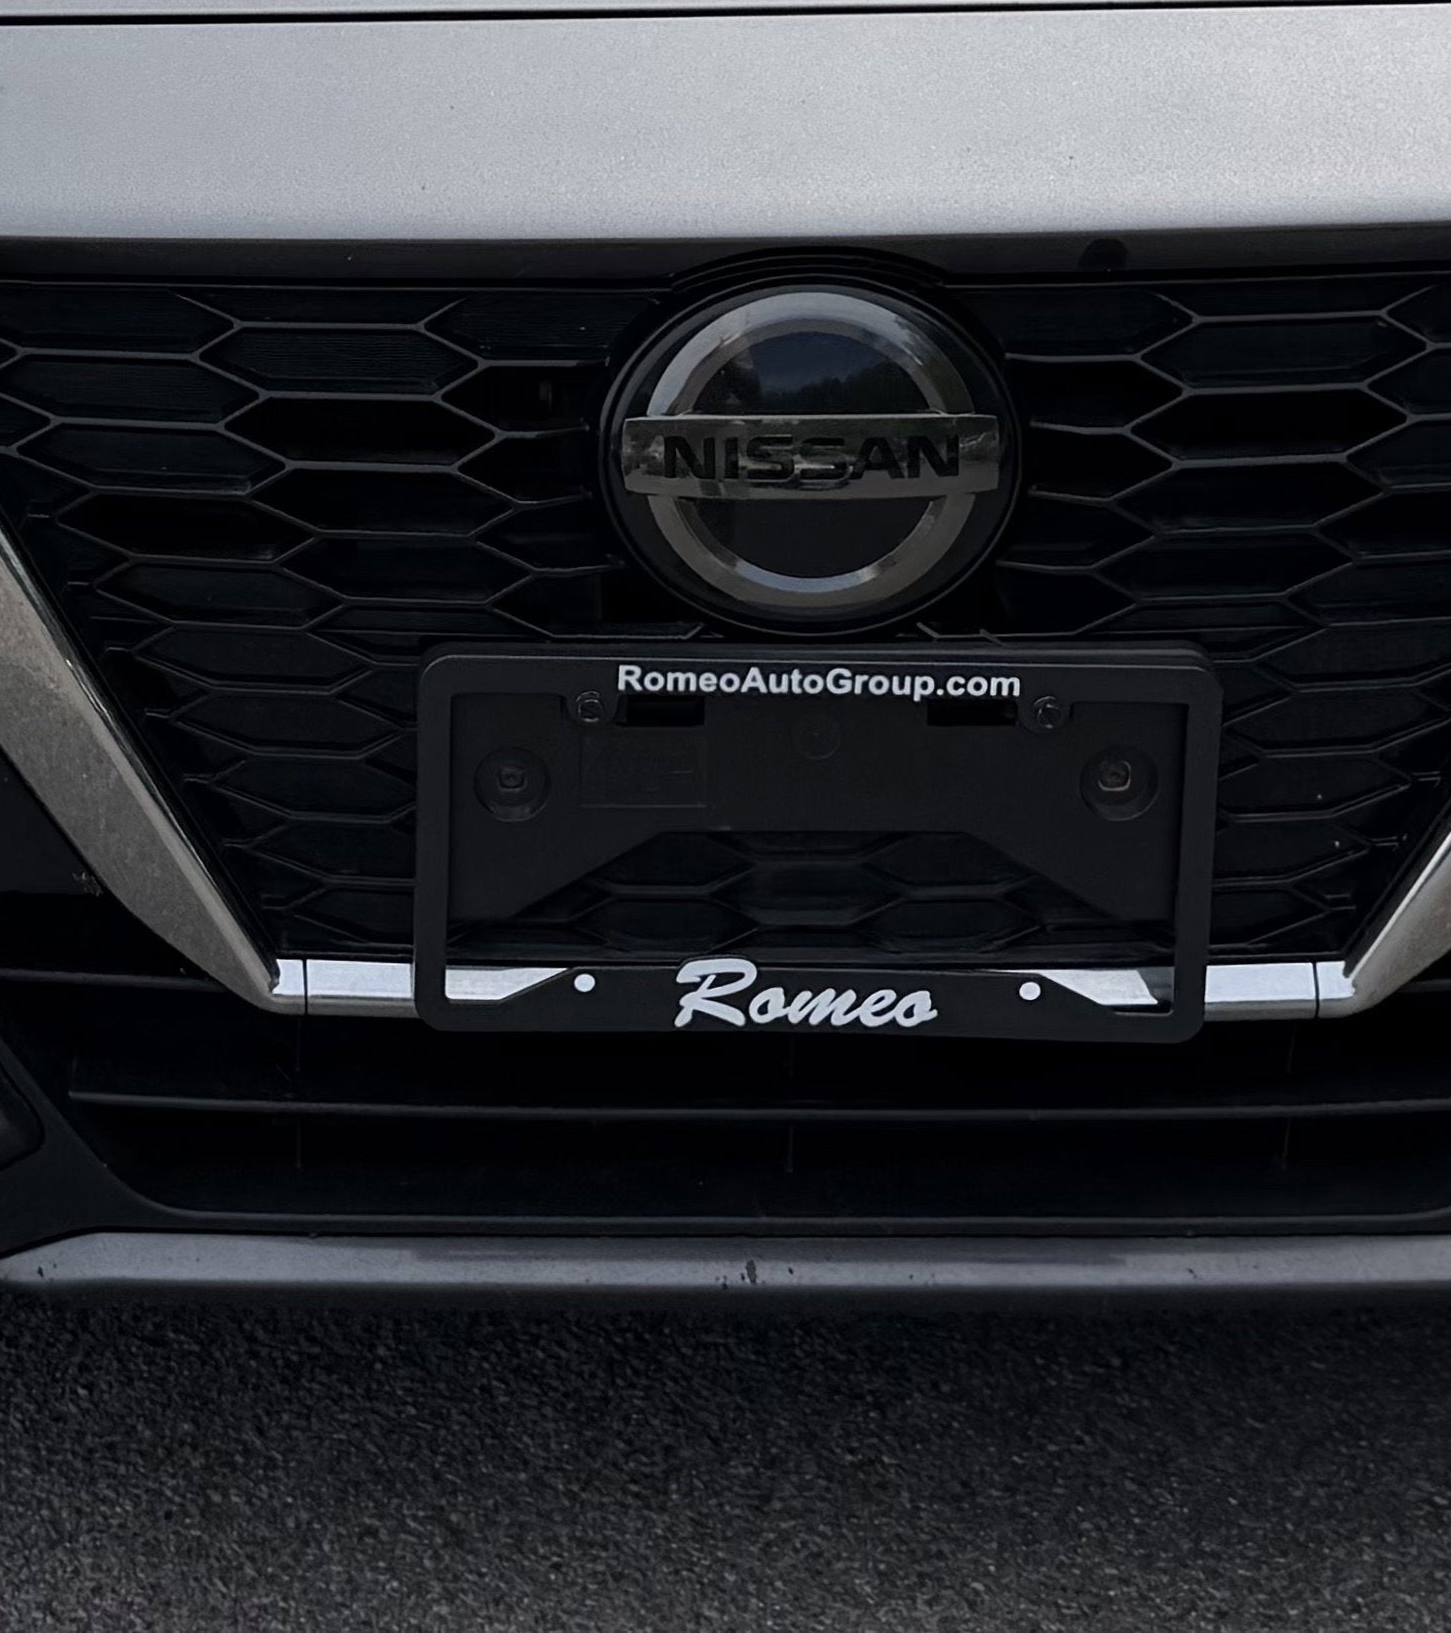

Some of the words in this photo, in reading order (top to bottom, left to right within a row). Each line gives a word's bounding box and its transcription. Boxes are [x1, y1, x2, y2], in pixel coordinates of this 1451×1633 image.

[663, 435, 961, 483] NISSAN
[617, 662, 1020, 701] RomeoAutoGroup.com
[675, 958, 938, 1027] Romeo
